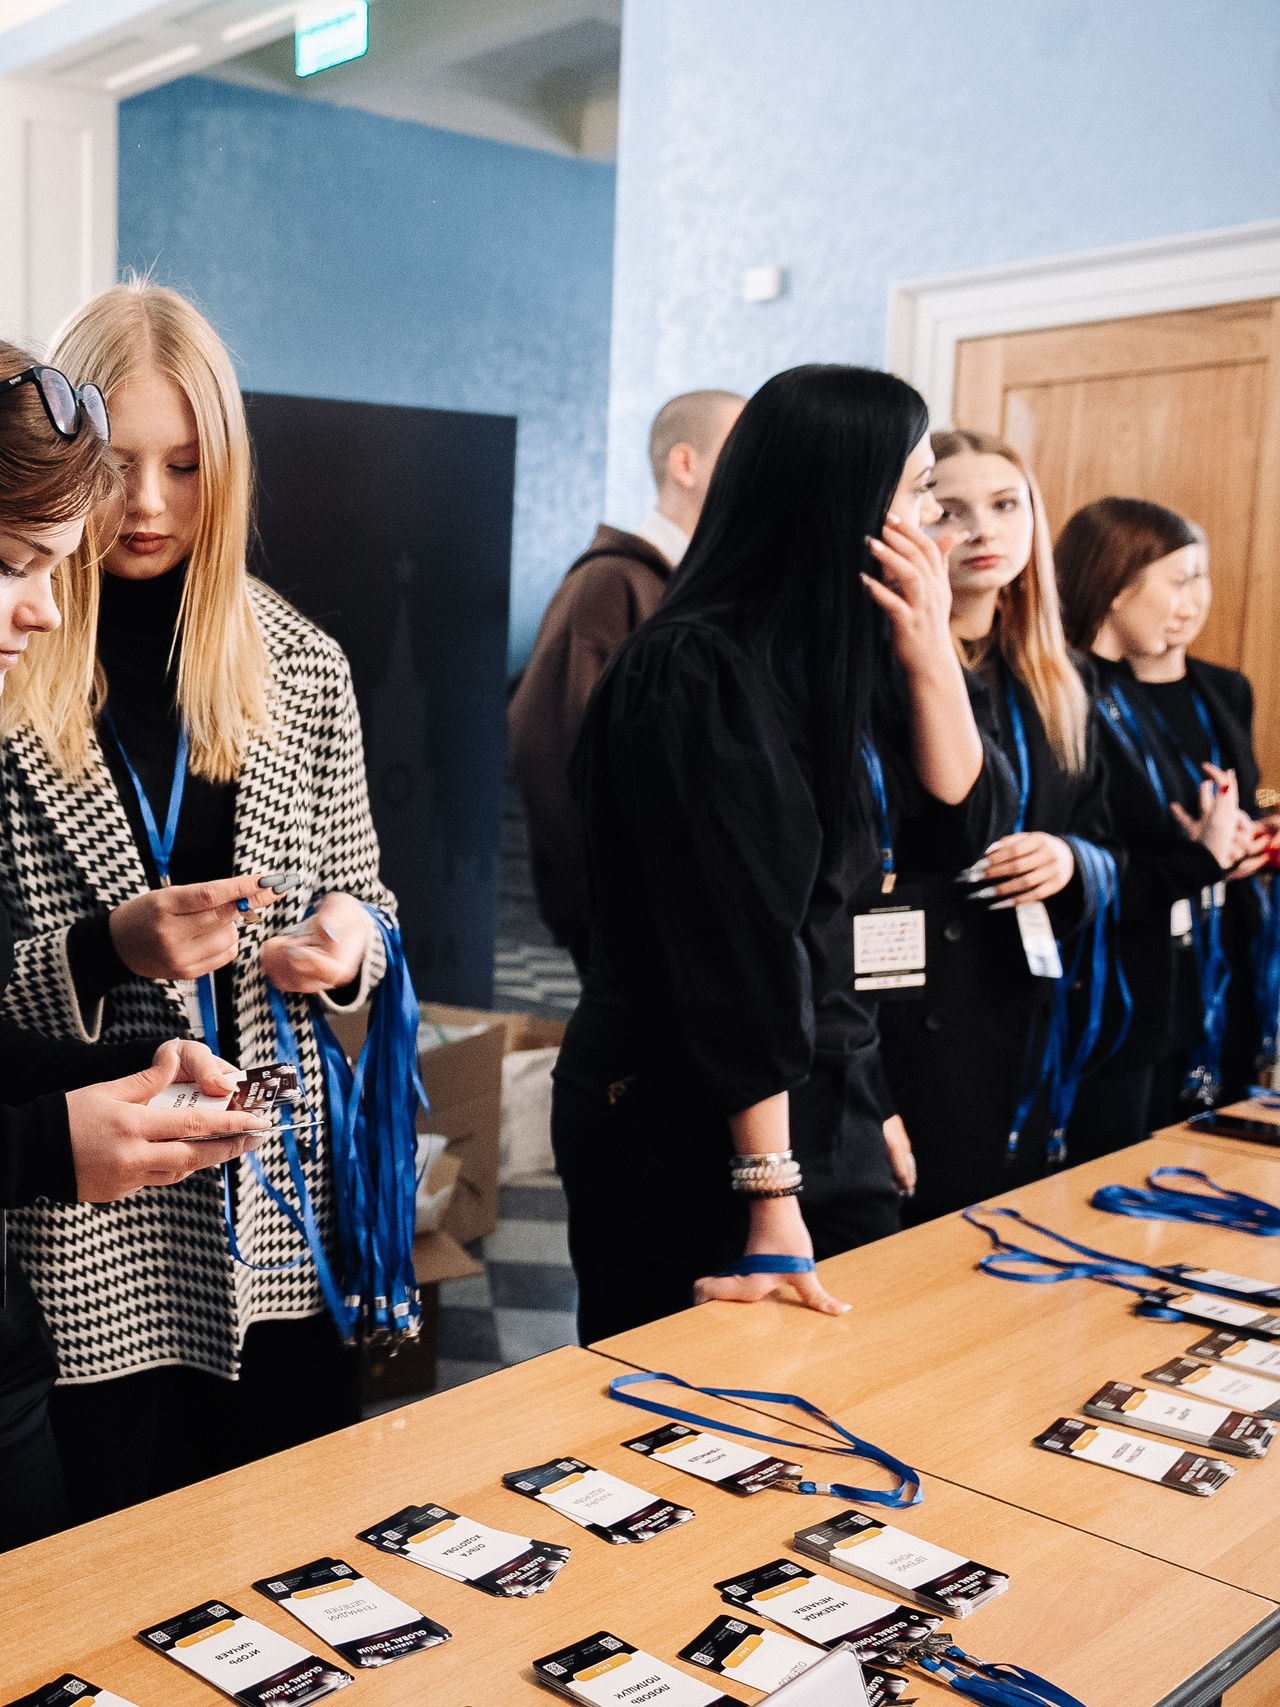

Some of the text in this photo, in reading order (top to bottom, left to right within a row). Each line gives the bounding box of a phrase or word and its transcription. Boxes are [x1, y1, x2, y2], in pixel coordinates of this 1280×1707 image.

[440, 1534, 482, 1556] ХОДОТОВА
[459, 1543, 486, 1558] ОЛЬГА
[518, 1556, 546, 1572] GLOBAL
[894, 1556, 928, 1573] ЕВГЕНИЙ
[495, 1568, 519, 1585] FORUM
[935, 1570, 986, 1596] GLOBAL FORUM
[324, 1599, 367, 1614] ЦЕПЕЛЕВ
[327, 1604, 377, 1622] ГЕННАДИЙ
[791, 1596, 834, 1616] НЕЧАЕВА
[801, 1600, 849, 1622] НАДЕЖДА
[197, 1630, 214, 1639] GOLD
[390, 1629, 427, 1644] GLOBAL
[874, 1621, 908, 1639] GLOBAL
[214, 1642, 254, 1661] ЧИЧАЕВ
[229, 1649, 261, 1665] ИГОРЬ
[357, 1641, 391, 1655] FORUM
[289, 1666, 323, 1685] GLOBAL
[595, 1663, 612, 1673] GOLD
[258, 1682, 291, 1700] FORUM
[613, 1674, 662, 1700] ПОЛИЩУК
[630, 1683, 671, 1706] ЛЮБОВЬ
